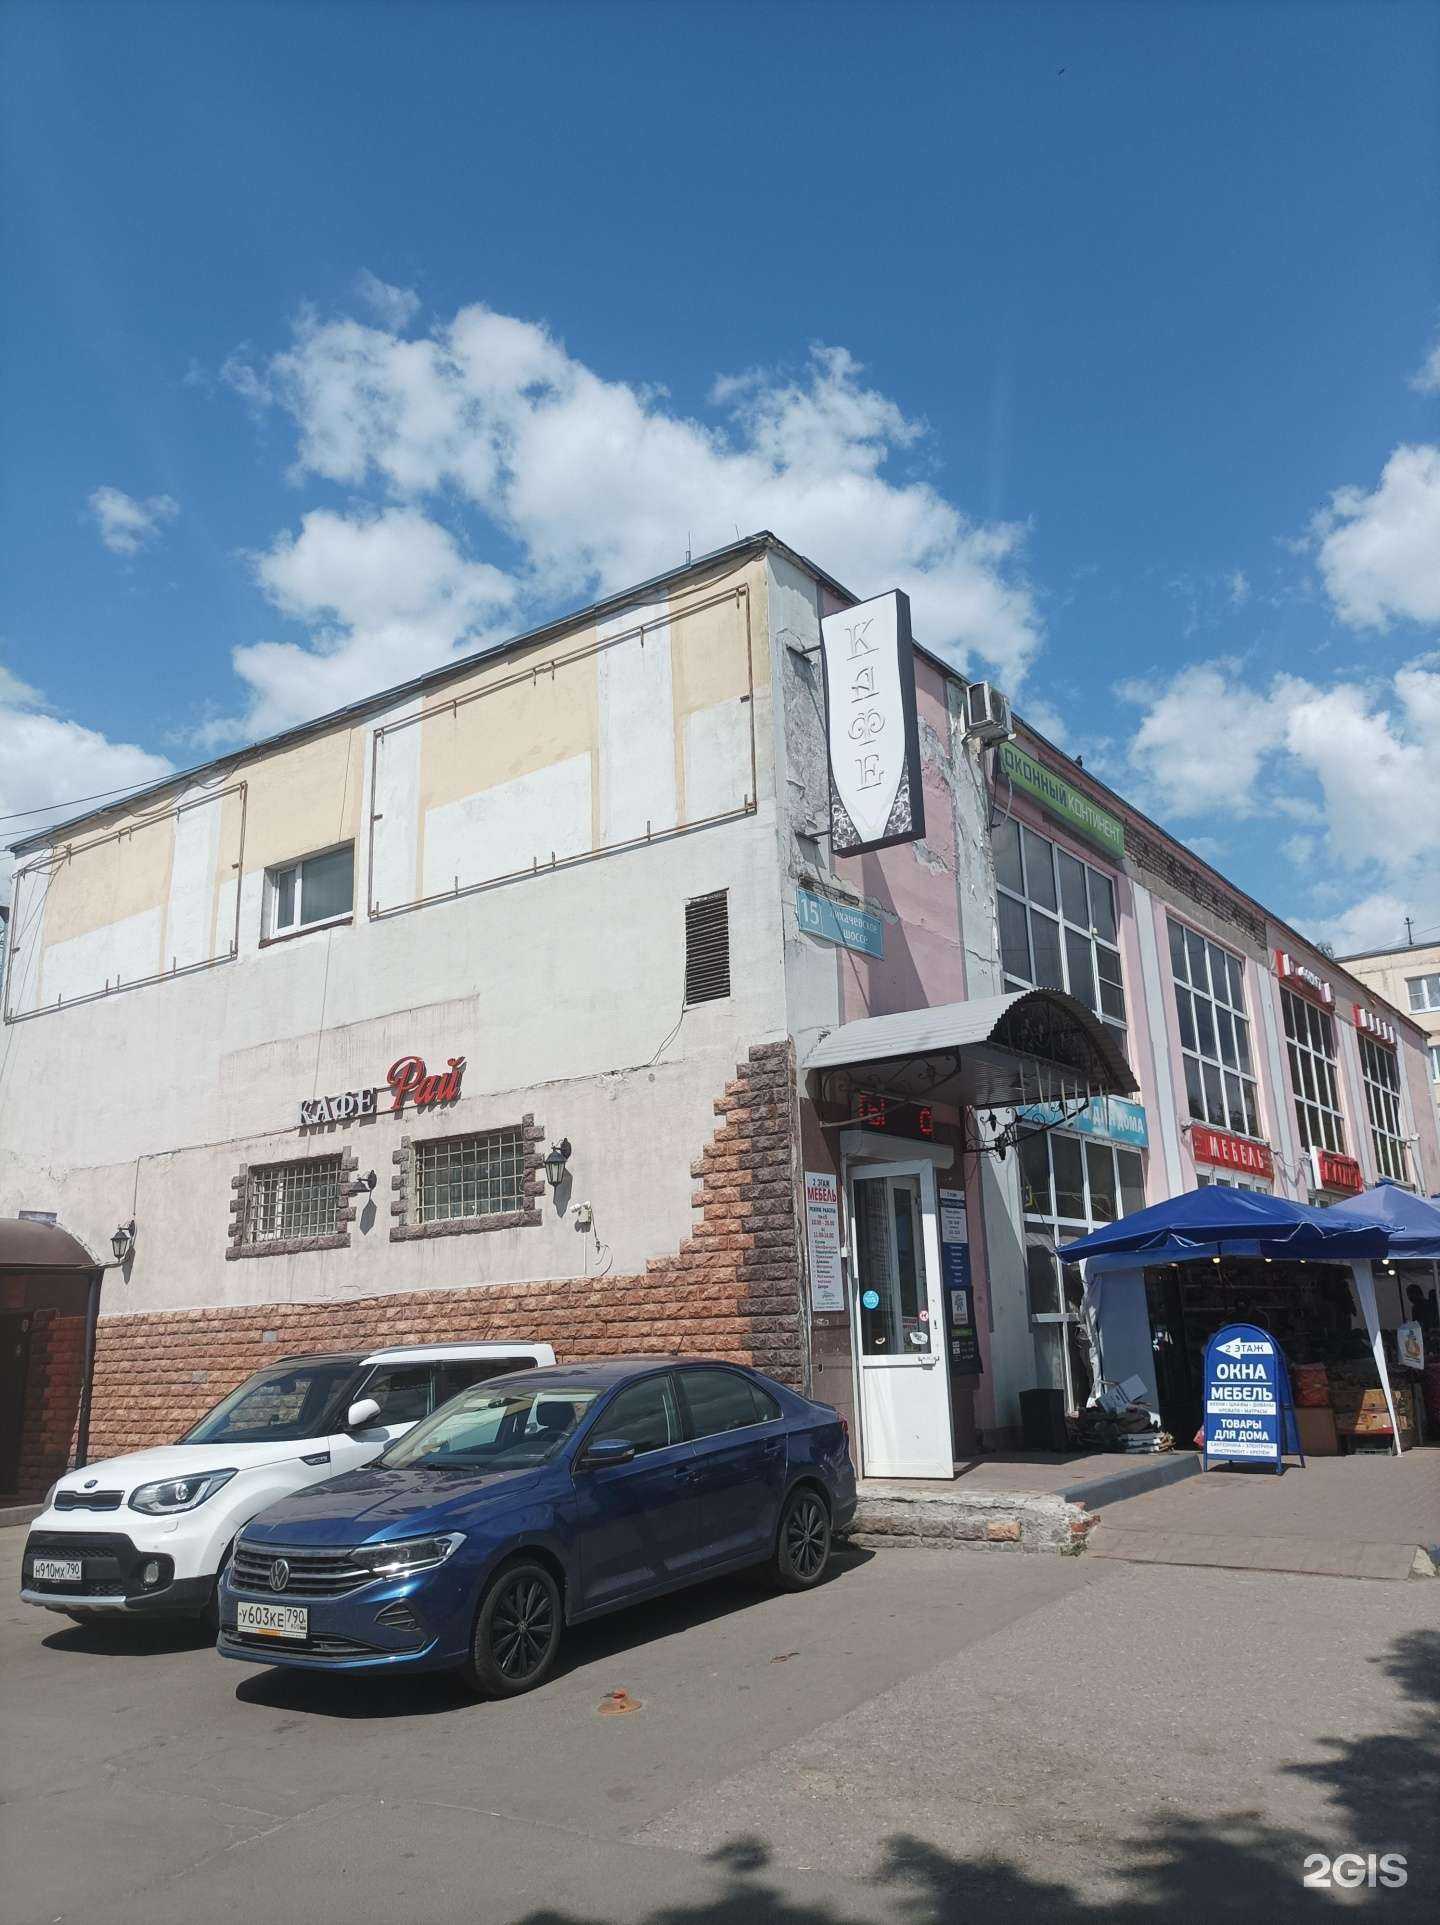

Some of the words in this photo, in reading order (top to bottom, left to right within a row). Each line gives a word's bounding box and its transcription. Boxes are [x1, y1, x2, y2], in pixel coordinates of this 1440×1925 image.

[1004, 747, 1068, 808] ОКОННЫЙ
[1068, 793, 1121, 843] КОНТИНЕНТ
[800, 897, 819, 925] 15
[296, 1087, 376, 1125] КАФЕ
[386, 1055, 466, 1111] Рай
[1209, 1135, 1264, 1169] МЕБЕЛЬ
[807, 1186, 837, 1203] МЕБЕЛЬ
[1234, 1344, 1265, 1353] ЭТАЖ
[1215, 1363, 1268, 1380] ОКНА
[1210, 1387, 1273, 1401] МЕБЕЛЬ
[1220, 1418, 1262, 1429] ТОВАРЫ
[1214, 1429, 1236, 1440] ДЛЯ
[1237, 1430, 1269, 1442] ДОМА
[241, 1606, 284, 1628] У603КЕ
[286, 1608, 305, 1624] 790
